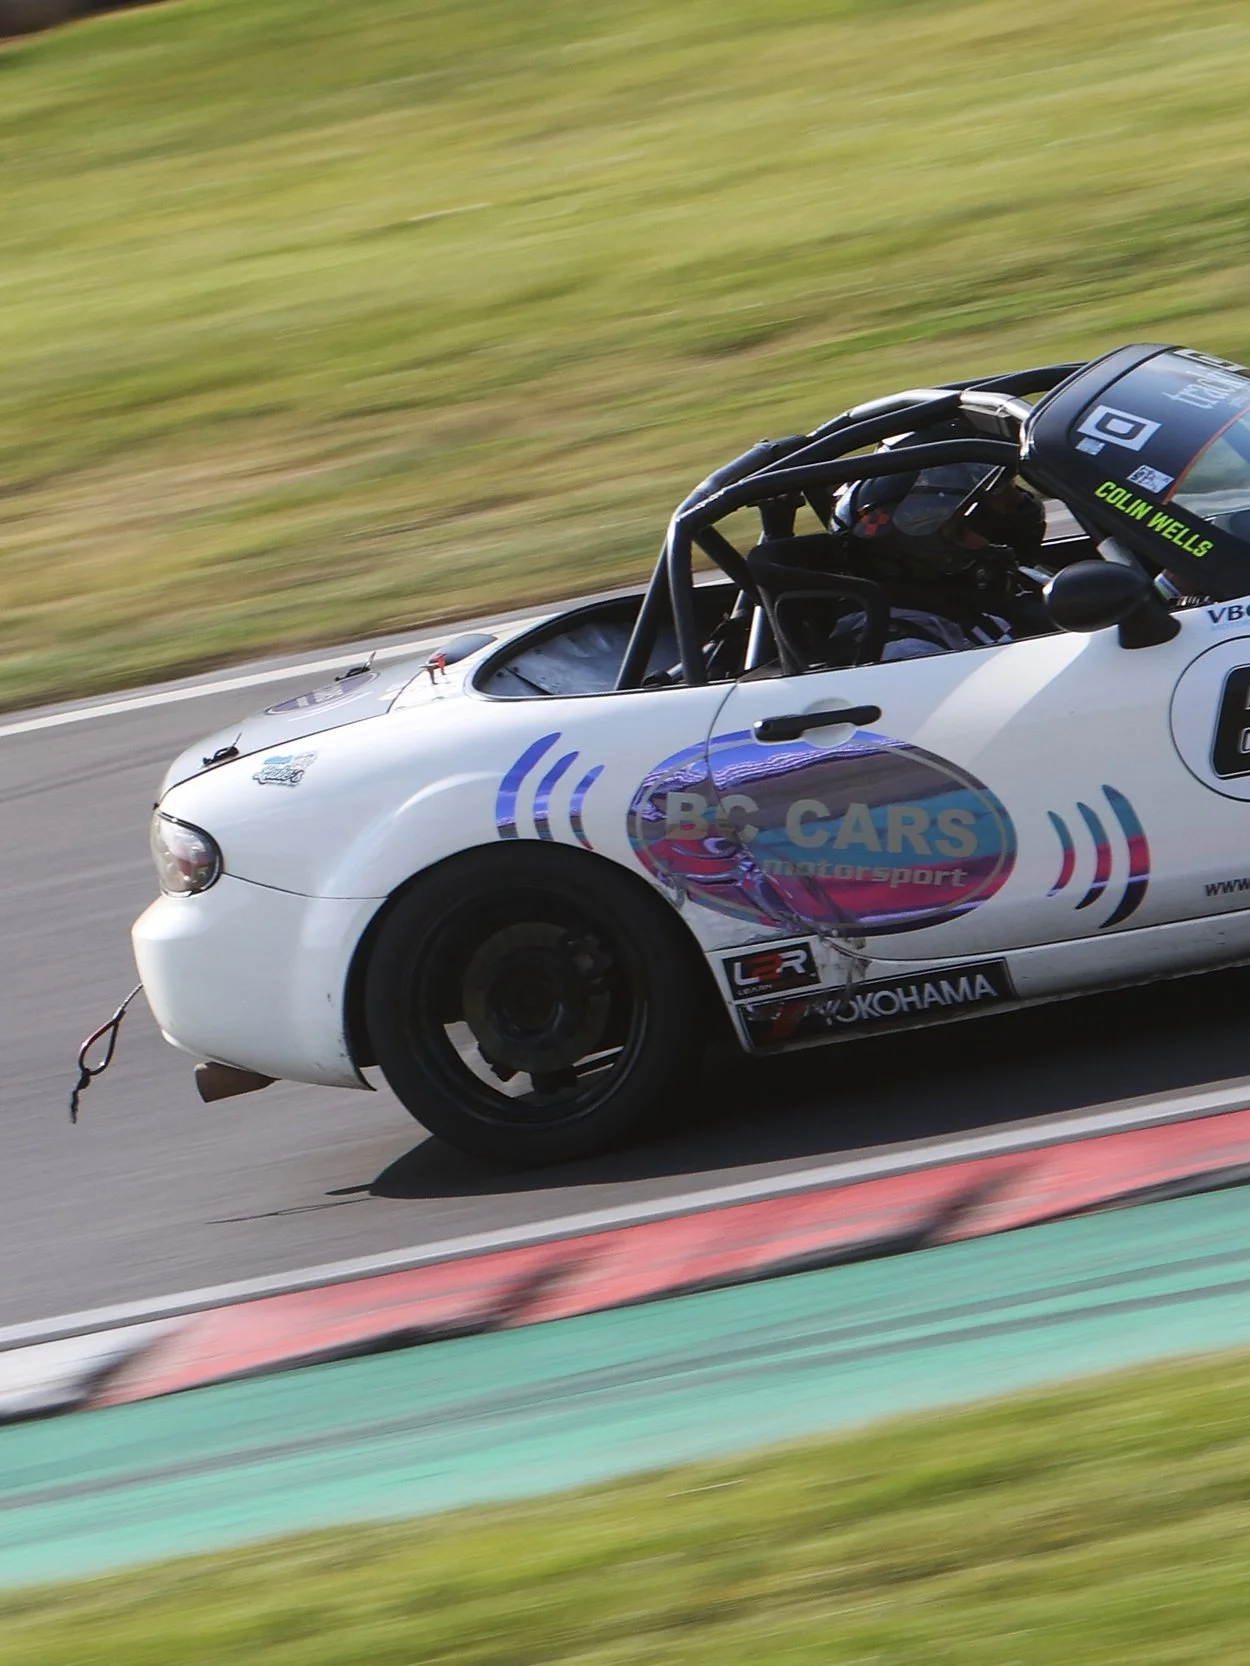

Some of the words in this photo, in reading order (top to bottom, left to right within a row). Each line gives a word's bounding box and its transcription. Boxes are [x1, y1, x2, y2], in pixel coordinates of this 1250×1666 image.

[1094, 481, 1154, 521] COLIN
[1146, 511, 1214, 558] WELLS
[665, 791, 760, 844] BC
[785, 799, 978, 858] CARS
[762, 858, 969, 888] motorsport
